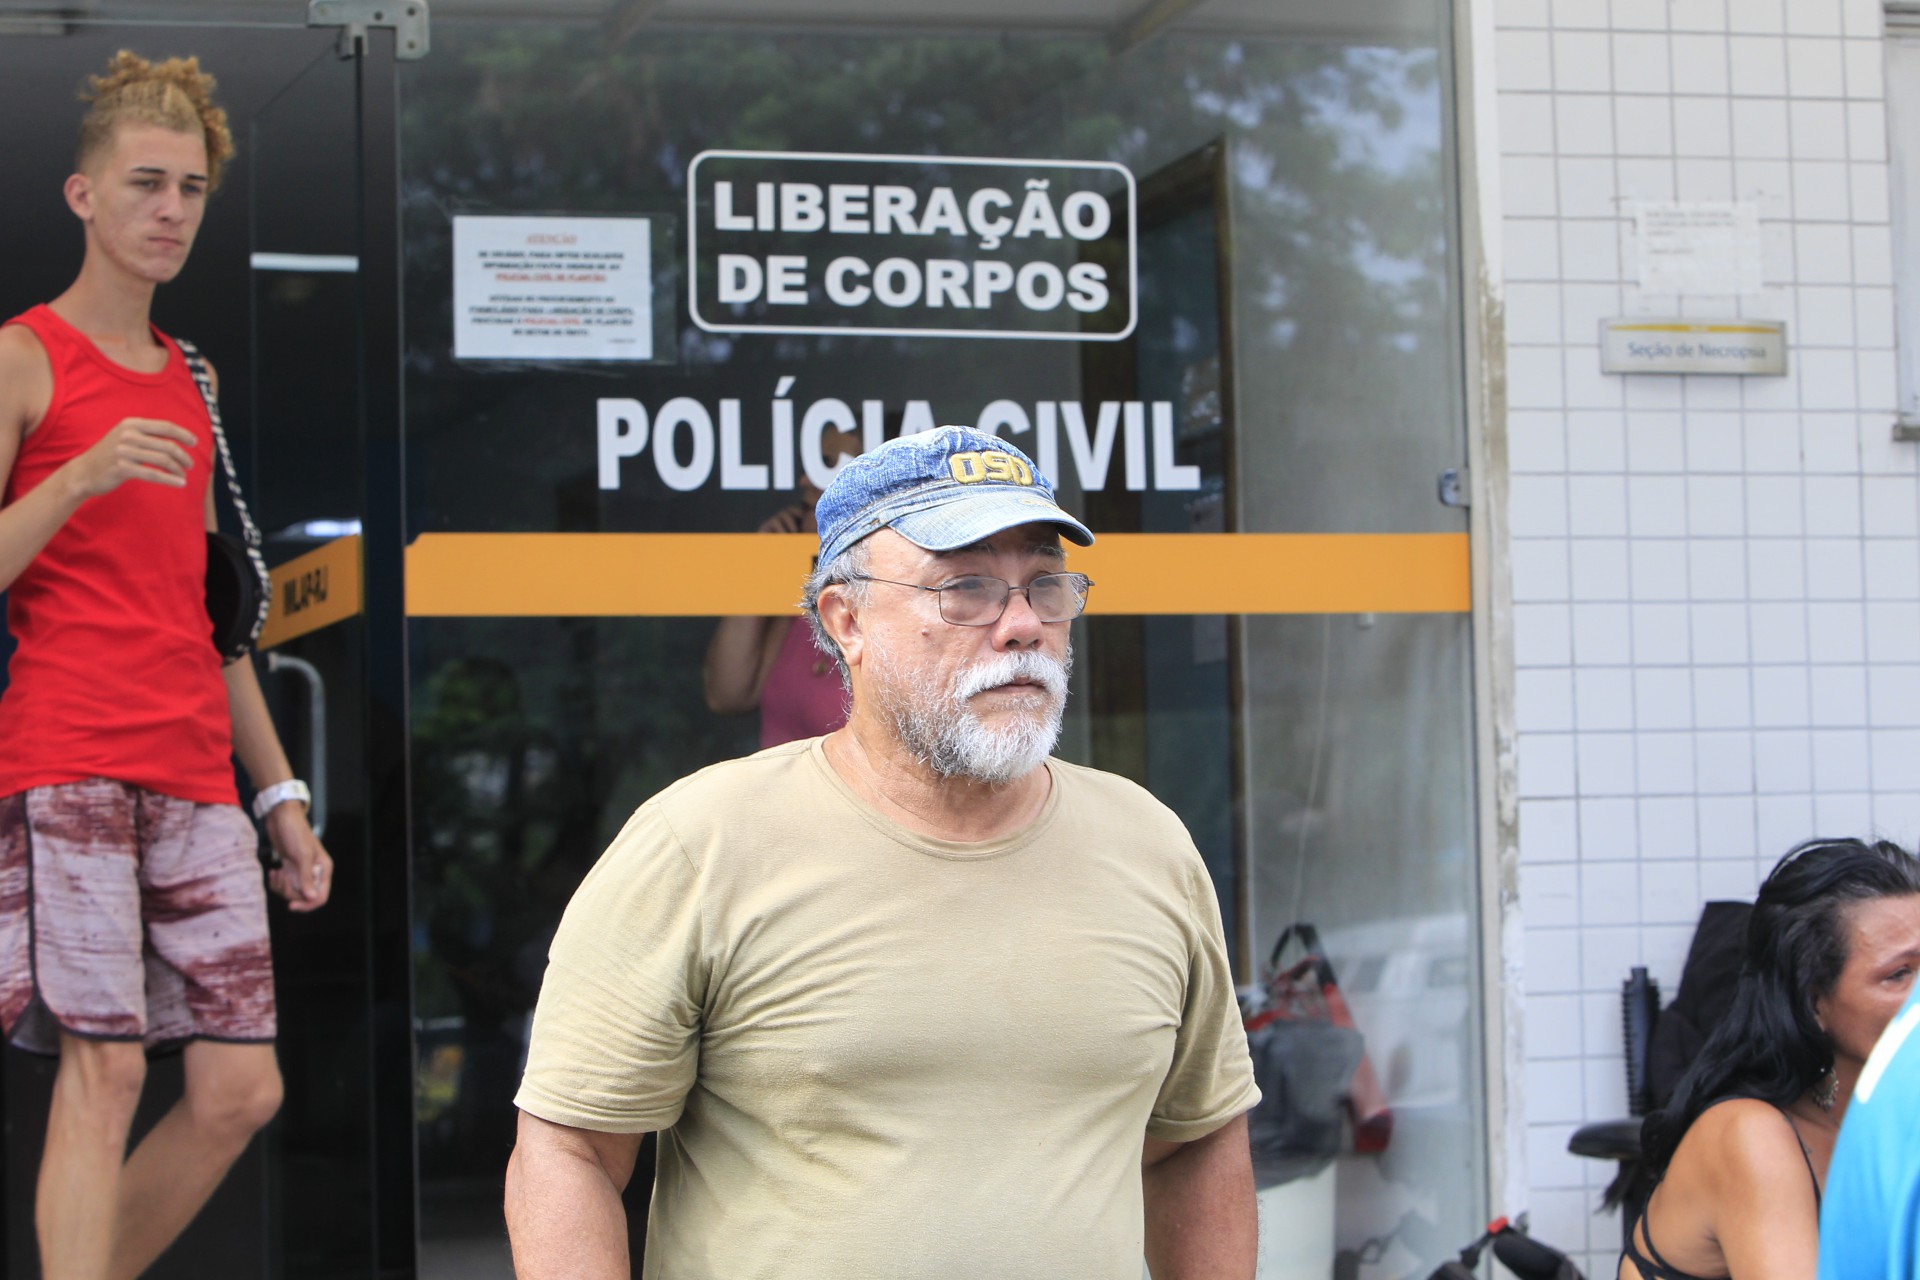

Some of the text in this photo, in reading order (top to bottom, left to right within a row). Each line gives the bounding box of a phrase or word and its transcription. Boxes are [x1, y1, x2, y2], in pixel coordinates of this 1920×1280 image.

[714, 179, 1111, 250] LIBERAÇÃO
[717, 254, 1110, 312] DE CORPOS
[1676, 344, 1693, 357] de
